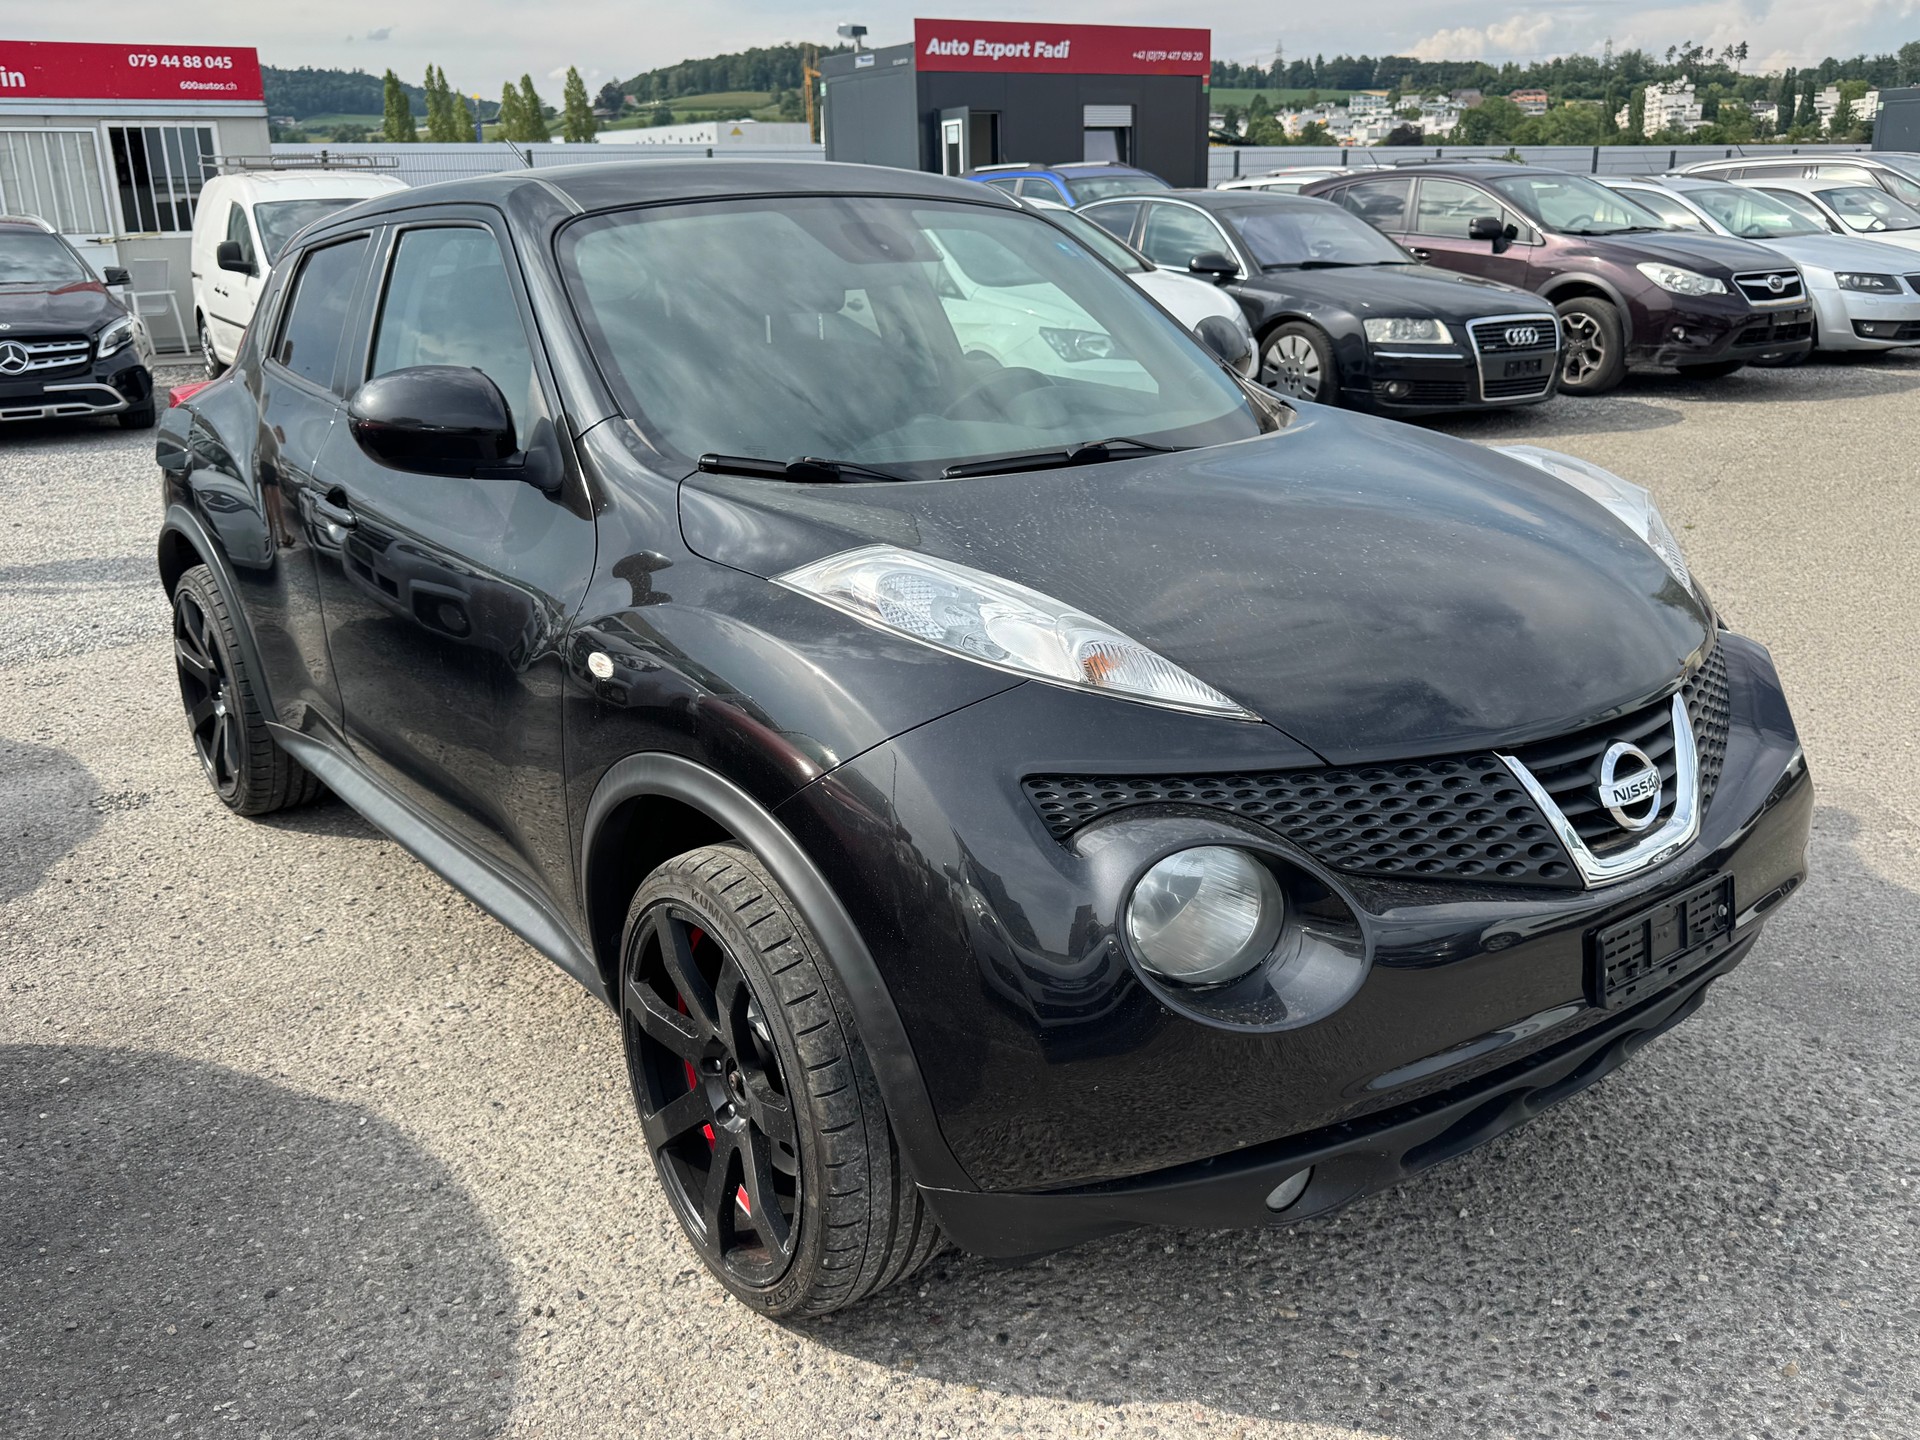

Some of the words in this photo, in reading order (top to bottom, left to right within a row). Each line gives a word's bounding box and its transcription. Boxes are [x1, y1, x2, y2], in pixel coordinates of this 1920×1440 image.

[128, 53, 158, 67] 079
[160, 55, 181, 68] 44
[182, 55, 202, 69] 88
[204, 56, 233, 69] 045
[926, 38, 970, 56] Auto
[973, 39, 1031, 61] Export
[1033, 40, 1071, 59] Fadi
[179, 80, 238, 91] 600autos.ch
[1612, 770, 1661, 803] NISSAN
[691, 888, 739, 944] KUMHO
